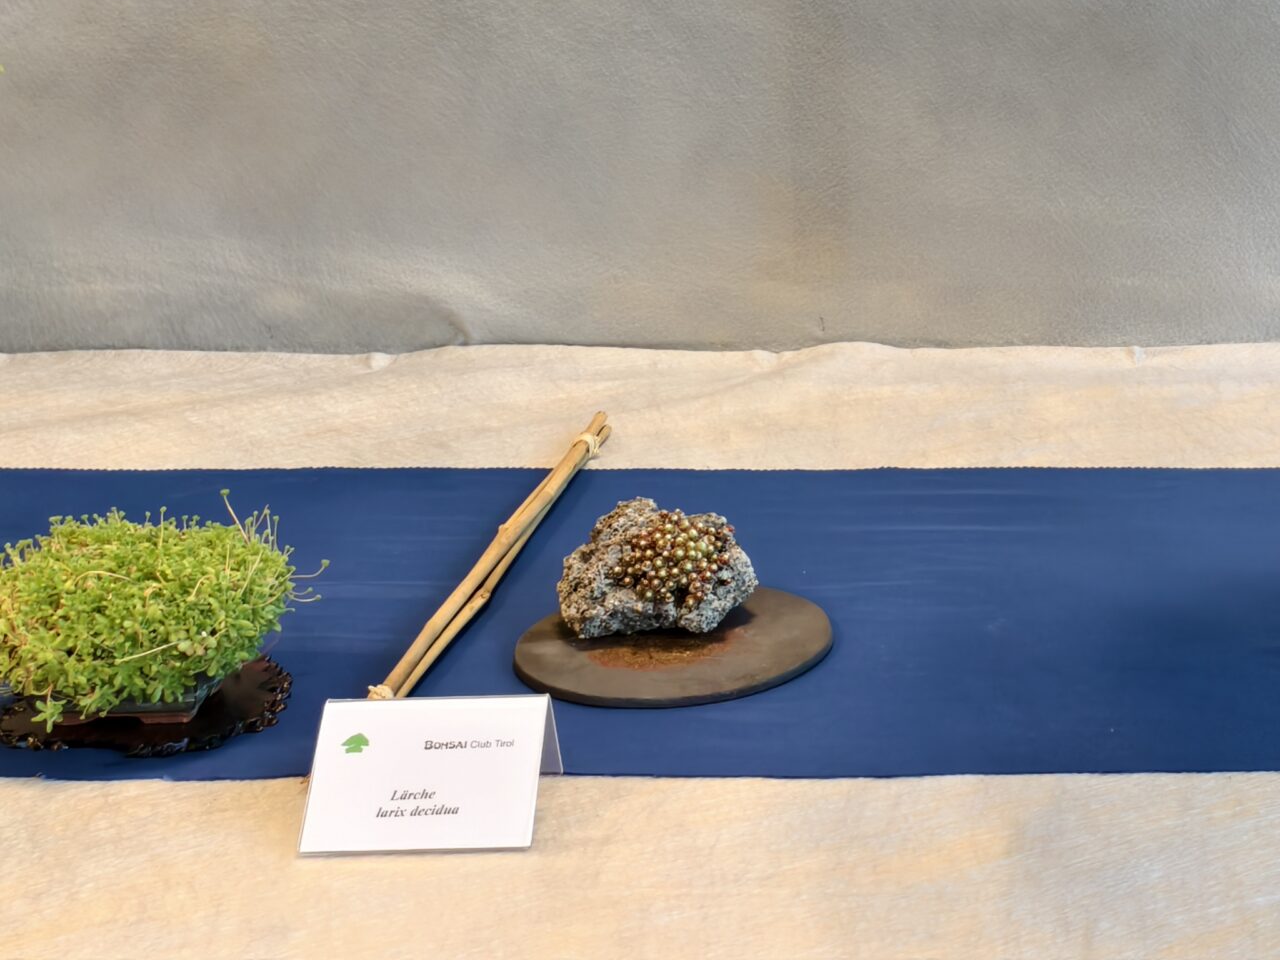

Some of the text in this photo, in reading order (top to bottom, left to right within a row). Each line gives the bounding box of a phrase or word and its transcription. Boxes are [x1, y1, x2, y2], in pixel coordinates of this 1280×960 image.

[469, 739, 492, 749] Club
[495, 738, 515, 748] Tirol
[390, 788, 436, 801] Lärche
[375, 804, 460, 818] larix decidua
